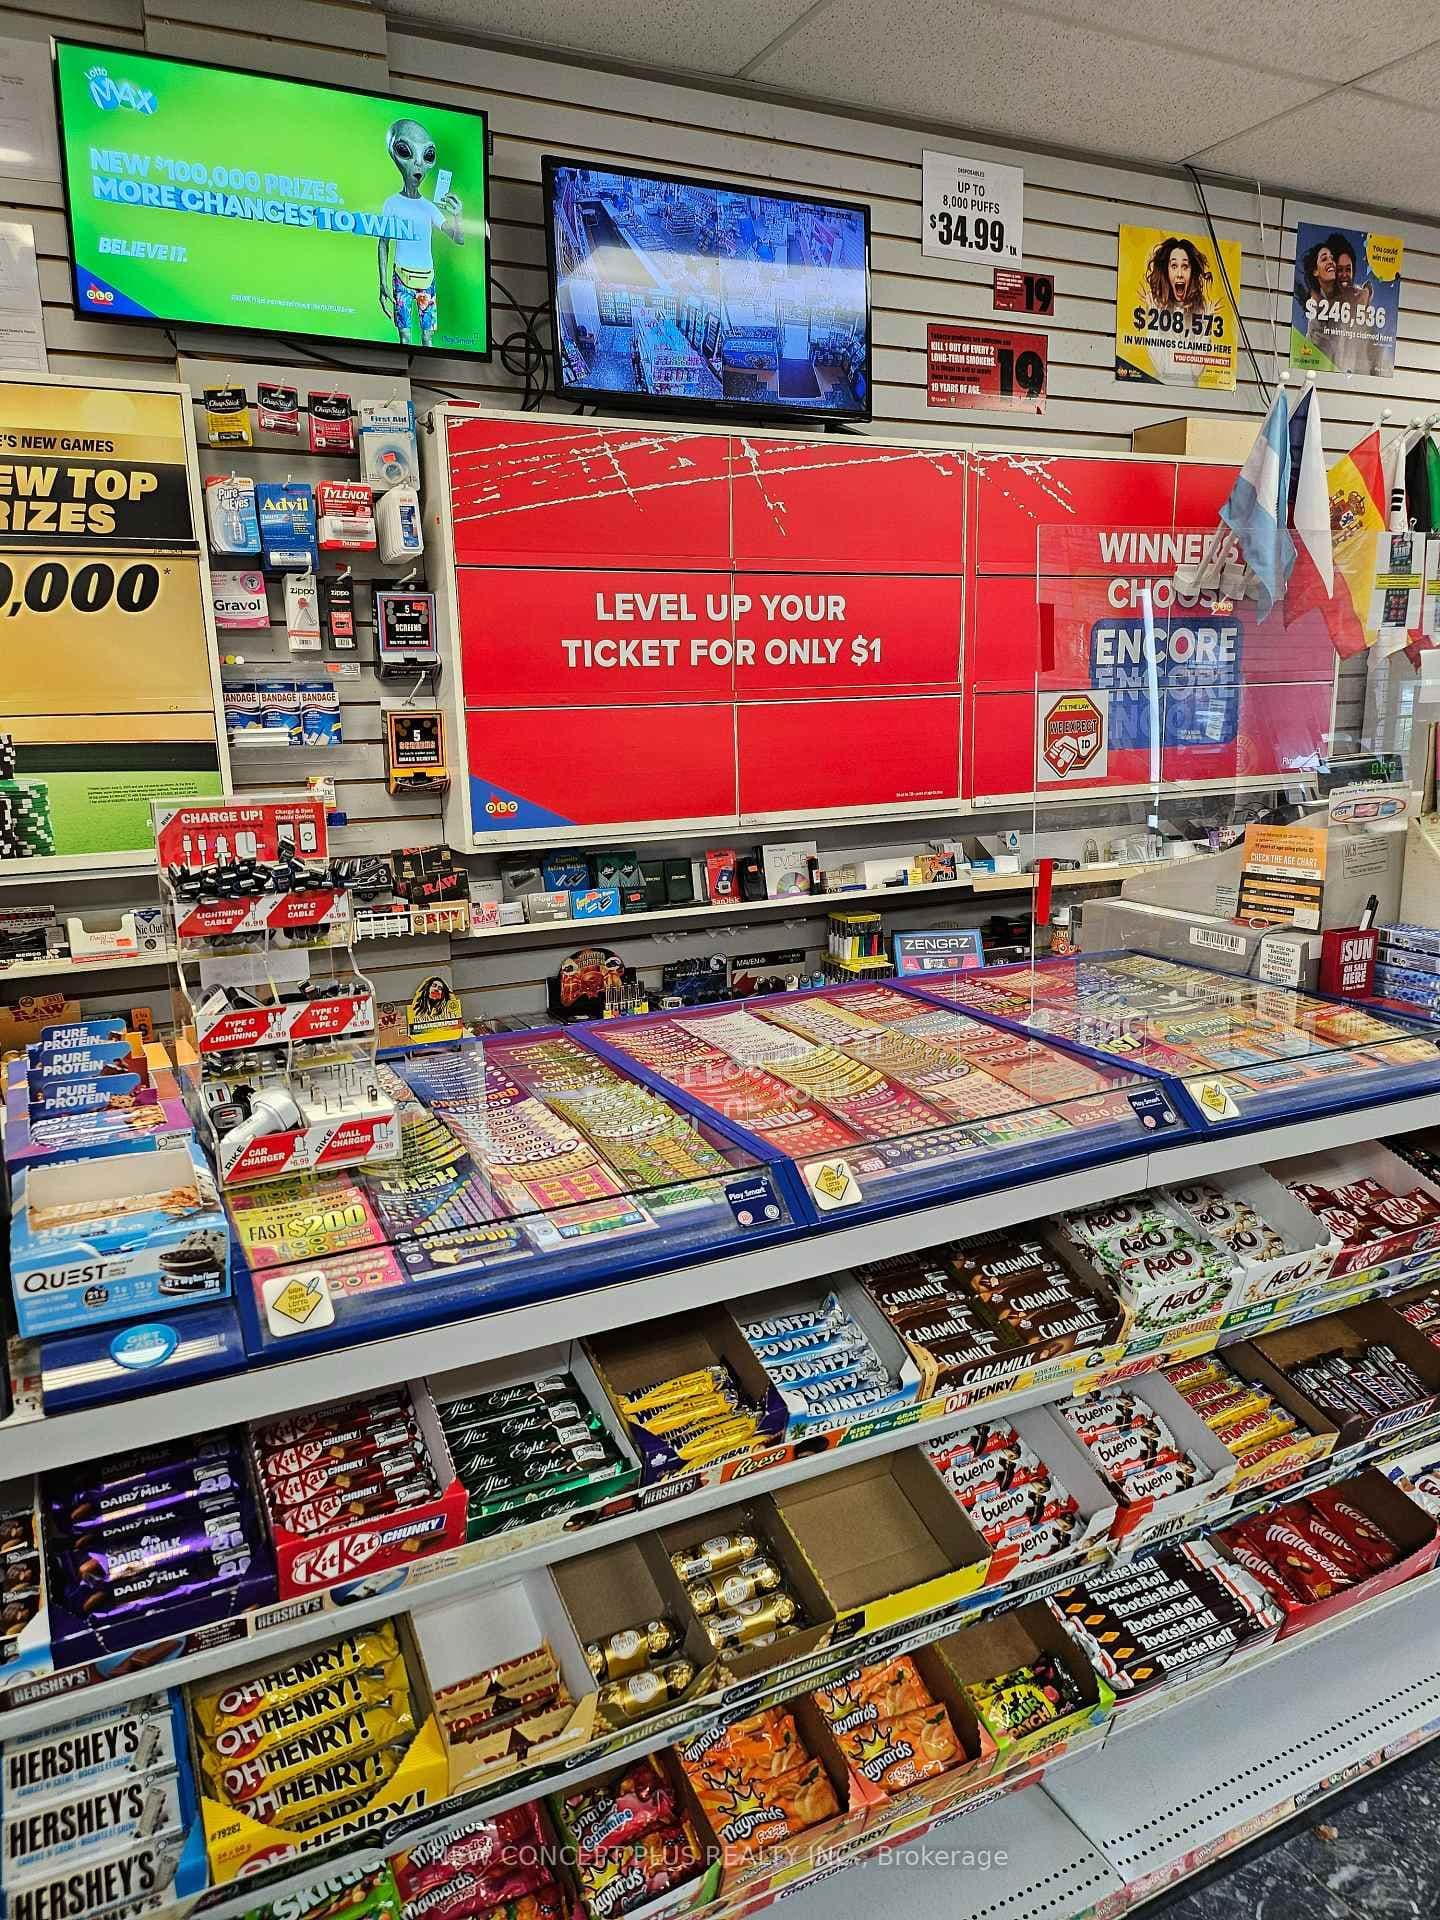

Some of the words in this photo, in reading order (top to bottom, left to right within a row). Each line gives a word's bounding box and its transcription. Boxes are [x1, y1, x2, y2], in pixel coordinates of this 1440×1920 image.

[87, 78, 157, 115] MAX
[89, 148, 150, 177] NEW
[155, 154, 261, 192] $100,000
[264, 174, 345, 205] PRIZES.
[957, 182, 971, 196] UP
[972, 184, 985, 197] TO
[93, 176, 180, 208] MORE
[180, 187, 315, 229] CHANCES
[316, 206, 359, 232] TO
[360, 215, 422, 241] WIN.
[942, 195, 968, 209] 8,000
[970, 199, 1000, 214] PUFFS
[929, 212, 1005, 253] $34.99
[98, 237, 170, 261] BELIEVE
[171, 245, 188, 263] IT.
[1372, 244, 1383, 253] You
[1382, 247, 1399, 256] could
[86, 288, 115, 304] OLG
[1024, 276, 1052, 313] 19
[1305, 299, 1387, 328] $246,536
[1133, 307, 1225, 339] $208,573
[1323, 326, 1330, 335] in
[1330, 328, 1356, 340] winnings
[930, 341, 944, 351] KILL
[949, 343, 961, 353] OUT
[962, 344, 970, 354] OF
[970, 345, 989, 355] EVERY
[989, 346, 995, 356] 2
[1124, 335, 1133, 346] IN
[1134, 336, 1176, 350] WINNINGS
[1177, 340, 1213, 353] CLAIMED
[1213, 343, 1232, 354] HERE
[930, 352, 965, 364] LONG-TERM
[1174, 354, 1187, 363] YOU
[1186, 355, 1204, 364] COULD
[997, 348, 1045, 399] 19
[930, 382, 939, 392] 19
[939, 383, 958, 394] YEARS
[959, 384, 968, 394] OF
[208, 398, 241, 408] ChapStick
[394, 416, 408, 424] Aid
[21, 436, 57, 451] NEW
[60, 438, 115, 453] GAMES
[67, 468, 158, 501] TOP
[217, 488, 239, 500] Pure
[322, 487, 370, 500] TYLENOL
[228, 498, 250, 511] Eyes
[263, 497, 309, 512] Advil
[289, 587, 315, 597] zippo
[330, 590, 350, 598] zippo
[213, 599, 261, 612] Gravol
[596, 592, 697, 622] LEVEL
[706, 594, 752, 622] UP
[760, 595, 846, 621] YOUR
[561, 639, 681, 668] TICKET
[690, 639, 756, 667] FOR
[764, 637, 844, 665] ONLY
[850, 634, 882, 668] $1
[1096, 627, 1238, 665] ENCORE
[261, 692, 297, 703] BANDAGE
[302, 691, 336, 702] BANDAGE
[1058, 704, 1069, 712] IT'S
[1068, 704, 1079, 712] THE
[1078, 704, 1091, 712] LAW
[1049, 720, 1064, 733] WE
[1063, 718, 1097, 733] EXPECT
[1081, 739, 1091, 750] ID
[484, 800, 519, 815] OLG
[181, 812, 238, 824] CHARGE
[240, 810, 264, 822] UP!
[1250, 852, 1270, 862] CHECK
[1270, 854, 1282, 864] THE
[1283, 856, 1296, 865] AGE
[1296, 857, 1317, 867] CHART
[421, 873, 459, 897] RAW
[287, 902, 308, 912] TYPE
[308, 902, 316, 910] C
[711, 896, 740, 906] SanDisk
[196, 909, 244, 921] LIGHTNING
[287, 910, 315, 919] CABLE
[204, 918, 233, 927] CABLE
[903, 937, 970, 950] ZENGAZ
[1341, 938, 1374, 962] SUN
[736, 957, 761, 967] MAVEN
[1342, 971, 1368, 985] HERE
[310, 1008, 332, 1017] TYPE
[332, 1005, 340, 1015] C
[224, 1019, 245, 1029] TYPE
[246, 1017, 256, 1027] C
[309, 1019, 331, 1029] TYPE
[331, 1016, 339, 1027] C
[52, 1027, 89, 1040] PURE
[209, 1030, 258, 1044] LIGHTNING
[42, 1035, 100, 1050] PROTEIN
[52, 1052, 89, 1064] PURE
[509, 1047, 543, 1056] Cash
[43, 1060, 104, 1076] PROTEIN
[331, 1133, 372, 1149] CHARGER
[337, 1130, 361, 1140] WALL
[241, 1151, 286, 1167] CHARGER
[248, 1147, 268, 1159] CAR
[249, 1222, 287, 1242] FAST
[287, 1203, 368, 1238] $200
[24, 1264, 109, 1293] QUEST
[883, 1281, 948, 1306] CARAMILK
[287, 1305, 311, 1315] TICKET
[742, 1312, 816, 1341] BOUNTY
[905, 1315, 973, 1344] CARAMILK
[944, 1393, 969, 1415] Oh
[966, 1375, 1020, 1405] HENRY!
[447, 1399, 478, 1420] After
[488, 1388, 524, 1408] Eight
[732, 1448, 787, 1480] Reese
[953, 1456, 995, 1488] bueno
[100, 1489, 139, 1510] DAIRY
[138, 1481, 173, 1500] MILK
[642, 1477, 697, 1507] HERSHEY'S
[982, 1492, 1025, 1523] bueno
[257, 1599, 322, 1629] HERSHEY'S
[218, 1677, 264, 1714] OH
[260, 1637, 362, 1692] HENRY!
[12, 1669, 89, 1702] HERSHEY'S
[1008, 1706, 1052, 1741] PATCH
[722, 1805, 785, 1843] Maynards
